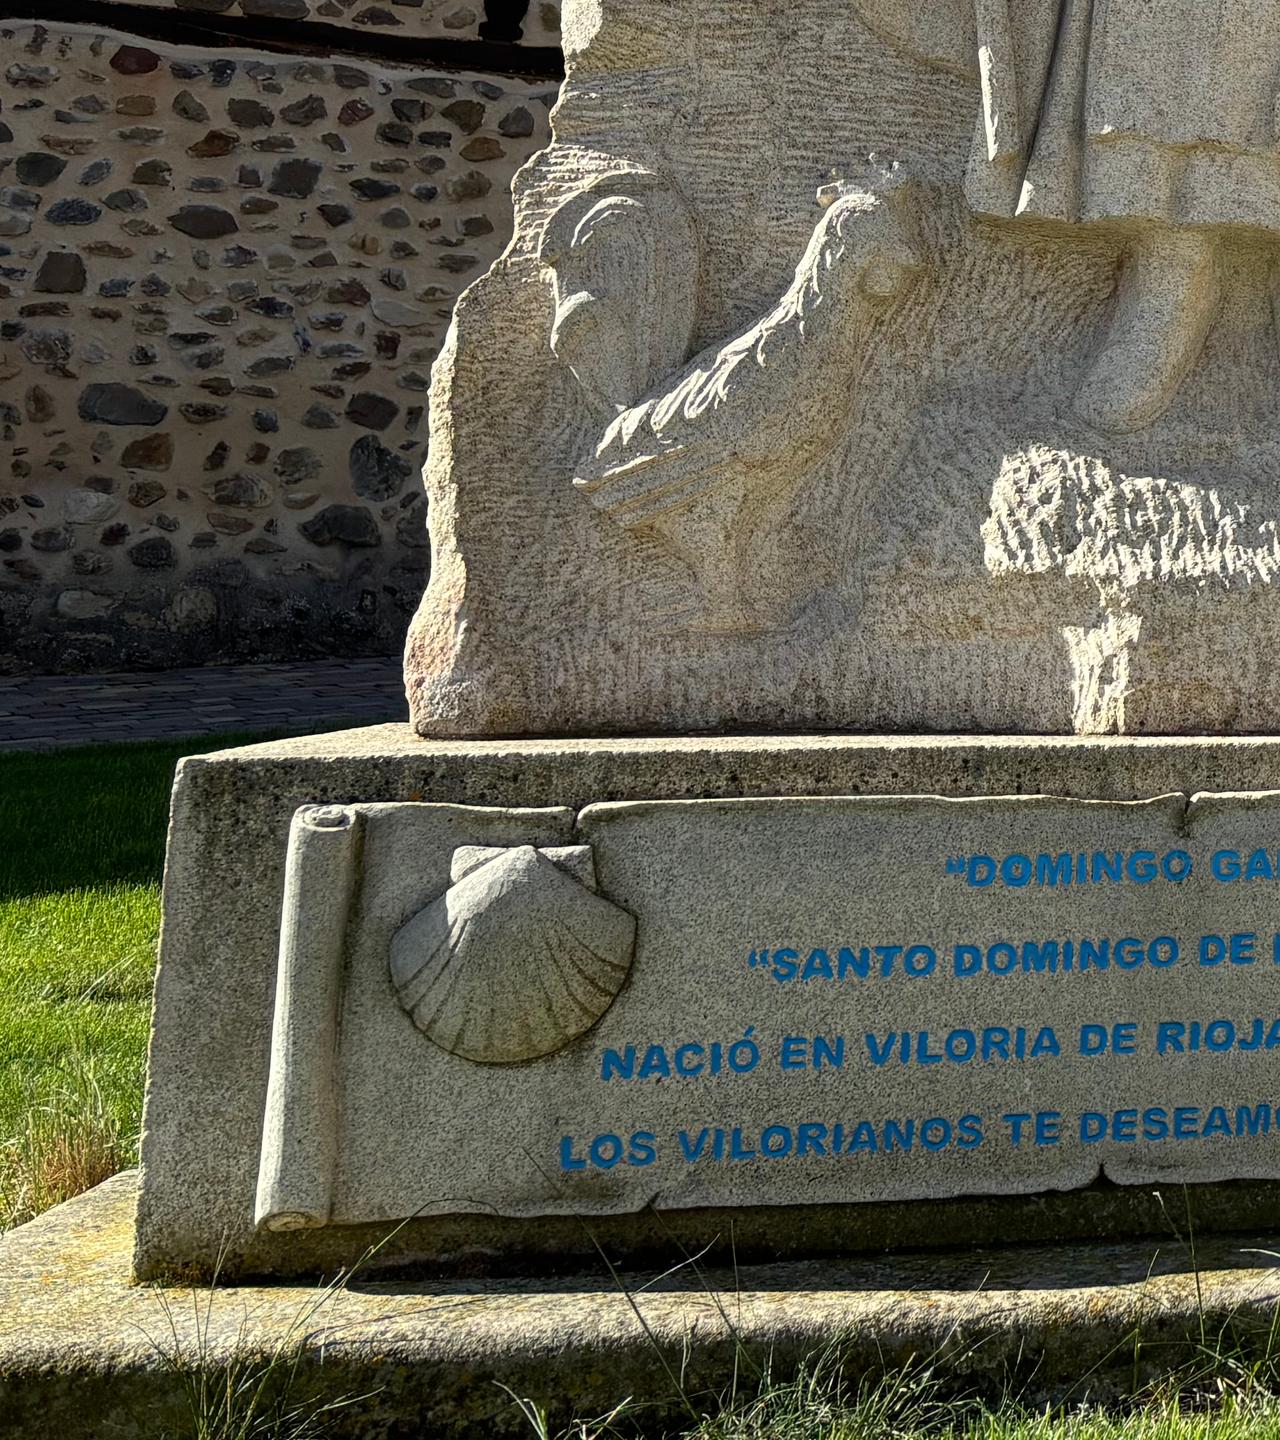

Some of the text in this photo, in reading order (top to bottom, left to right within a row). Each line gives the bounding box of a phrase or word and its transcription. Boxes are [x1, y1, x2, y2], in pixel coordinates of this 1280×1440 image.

[953, 936, 1181, 979] DOMINGO
[1199, 933, 1256, 968] DE
[602, 1027, 763, 1082] NACIÓ
[780, 1036, 847, 1072] EN
[865, 1026, 1063, 1068] VILORIA
[1079, 1023, 1139, 1059] DE
[560, 1131, 658, 1171] LOS
[679, 1113, 985, 1164] VILORIANOS
[1003, 1111, 1063, 1147] TE
